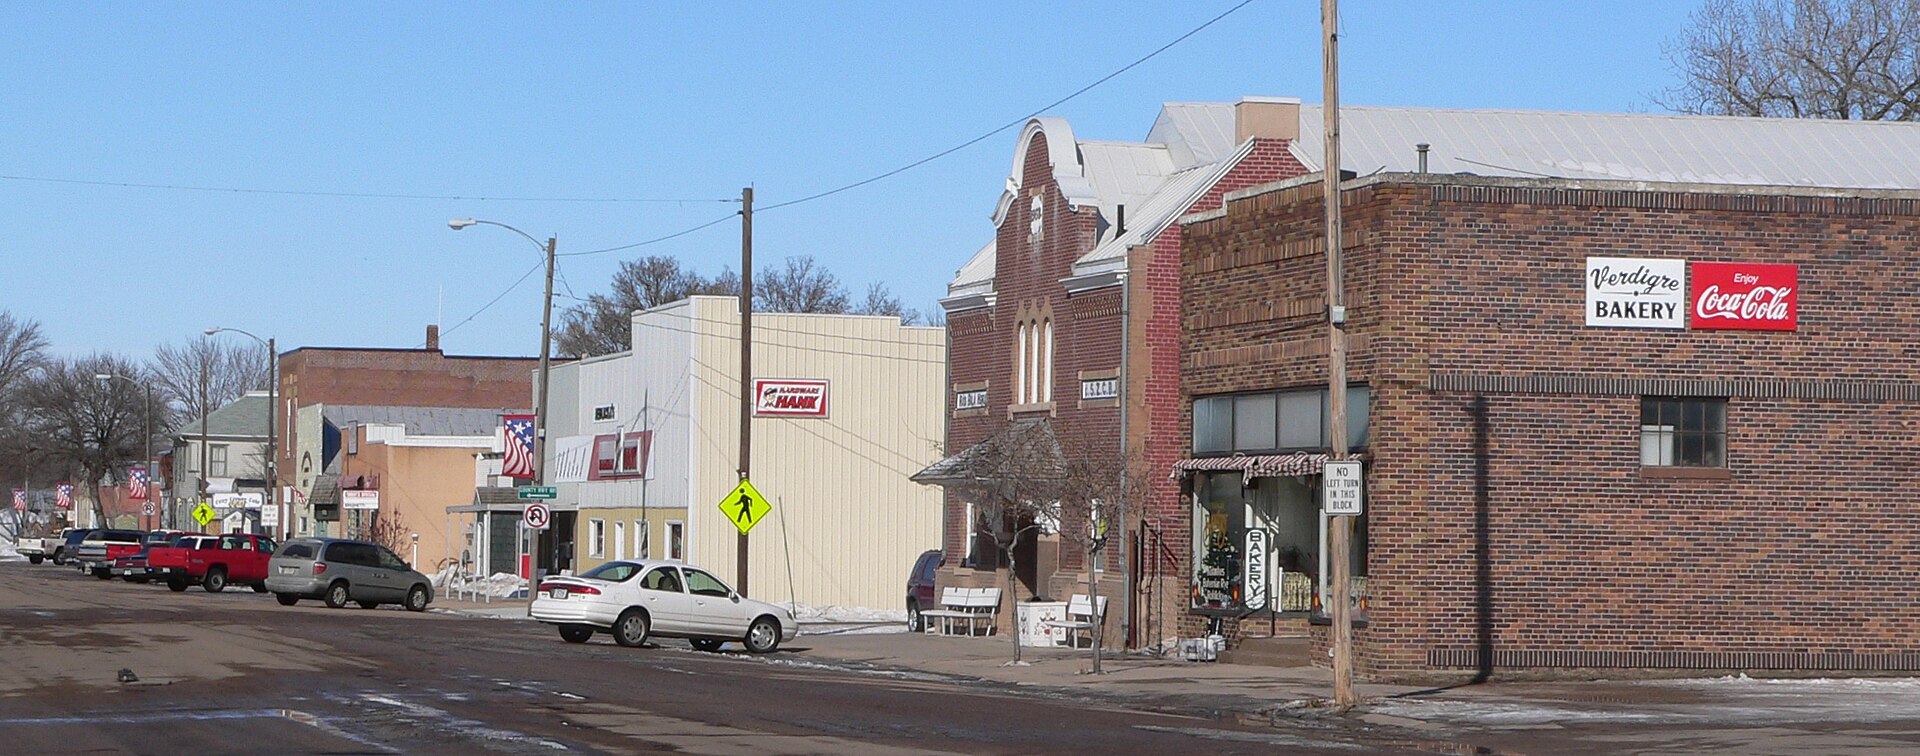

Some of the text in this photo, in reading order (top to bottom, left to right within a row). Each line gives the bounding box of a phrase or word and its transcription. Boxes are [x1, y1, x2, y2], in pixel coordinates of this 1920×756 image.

[1590, 265, 1680, 293] Verdigre
[1733, 273, 1759, 285] Enjoy
[1696, 284, 1792, 320] Coca-Cola
[1595, 300, 1678, 320] BAKERY
[779, 386, 820, 394] HARDWARE
[774, 395, 820, 409] HANK
[1336, 467, 1349, 477] NO
[1326, 479, 1359, 488] LEFT TURN
[1330, 490, 1355, 498] IN THIS
[1333, 501, 1353, 510] BLOCK
[1249, 531, 1262, 597] BAKERY
